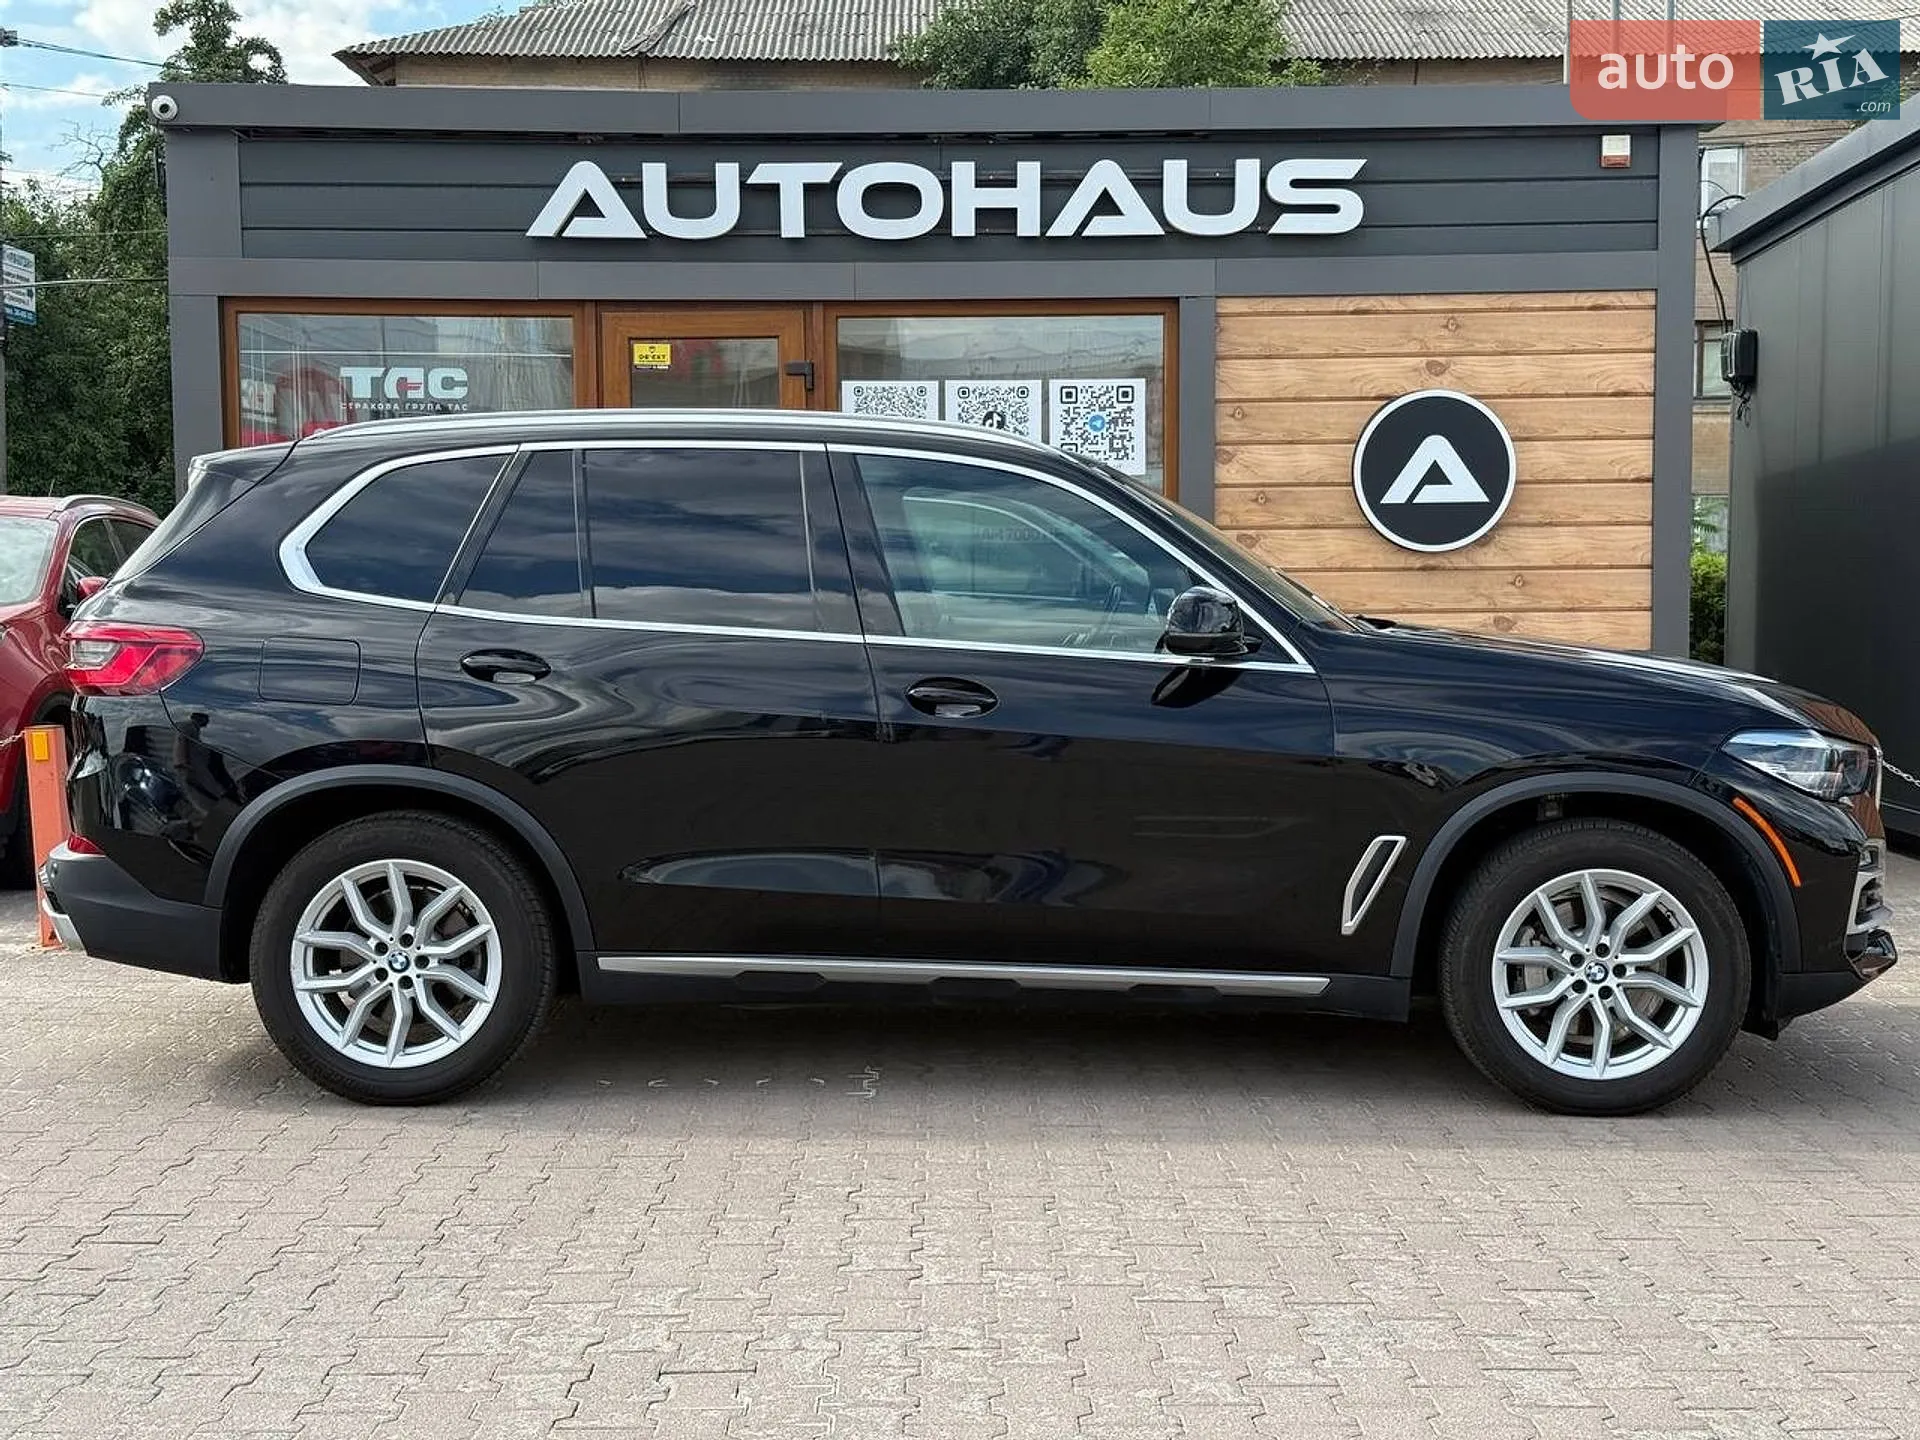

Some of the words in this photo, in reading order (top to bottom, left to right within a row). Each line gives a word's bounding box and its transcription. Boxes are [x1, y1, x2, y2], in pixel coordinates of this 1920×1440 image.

[525, 158, 1368, 241] AUTOHAUS
[340, 402, 400, 411] СТРАХОВА
[404, 402, 442, 411] ГРУПА
[447, 402, 469, 412] ТАС
[1379, 434, 1490, 504] A
